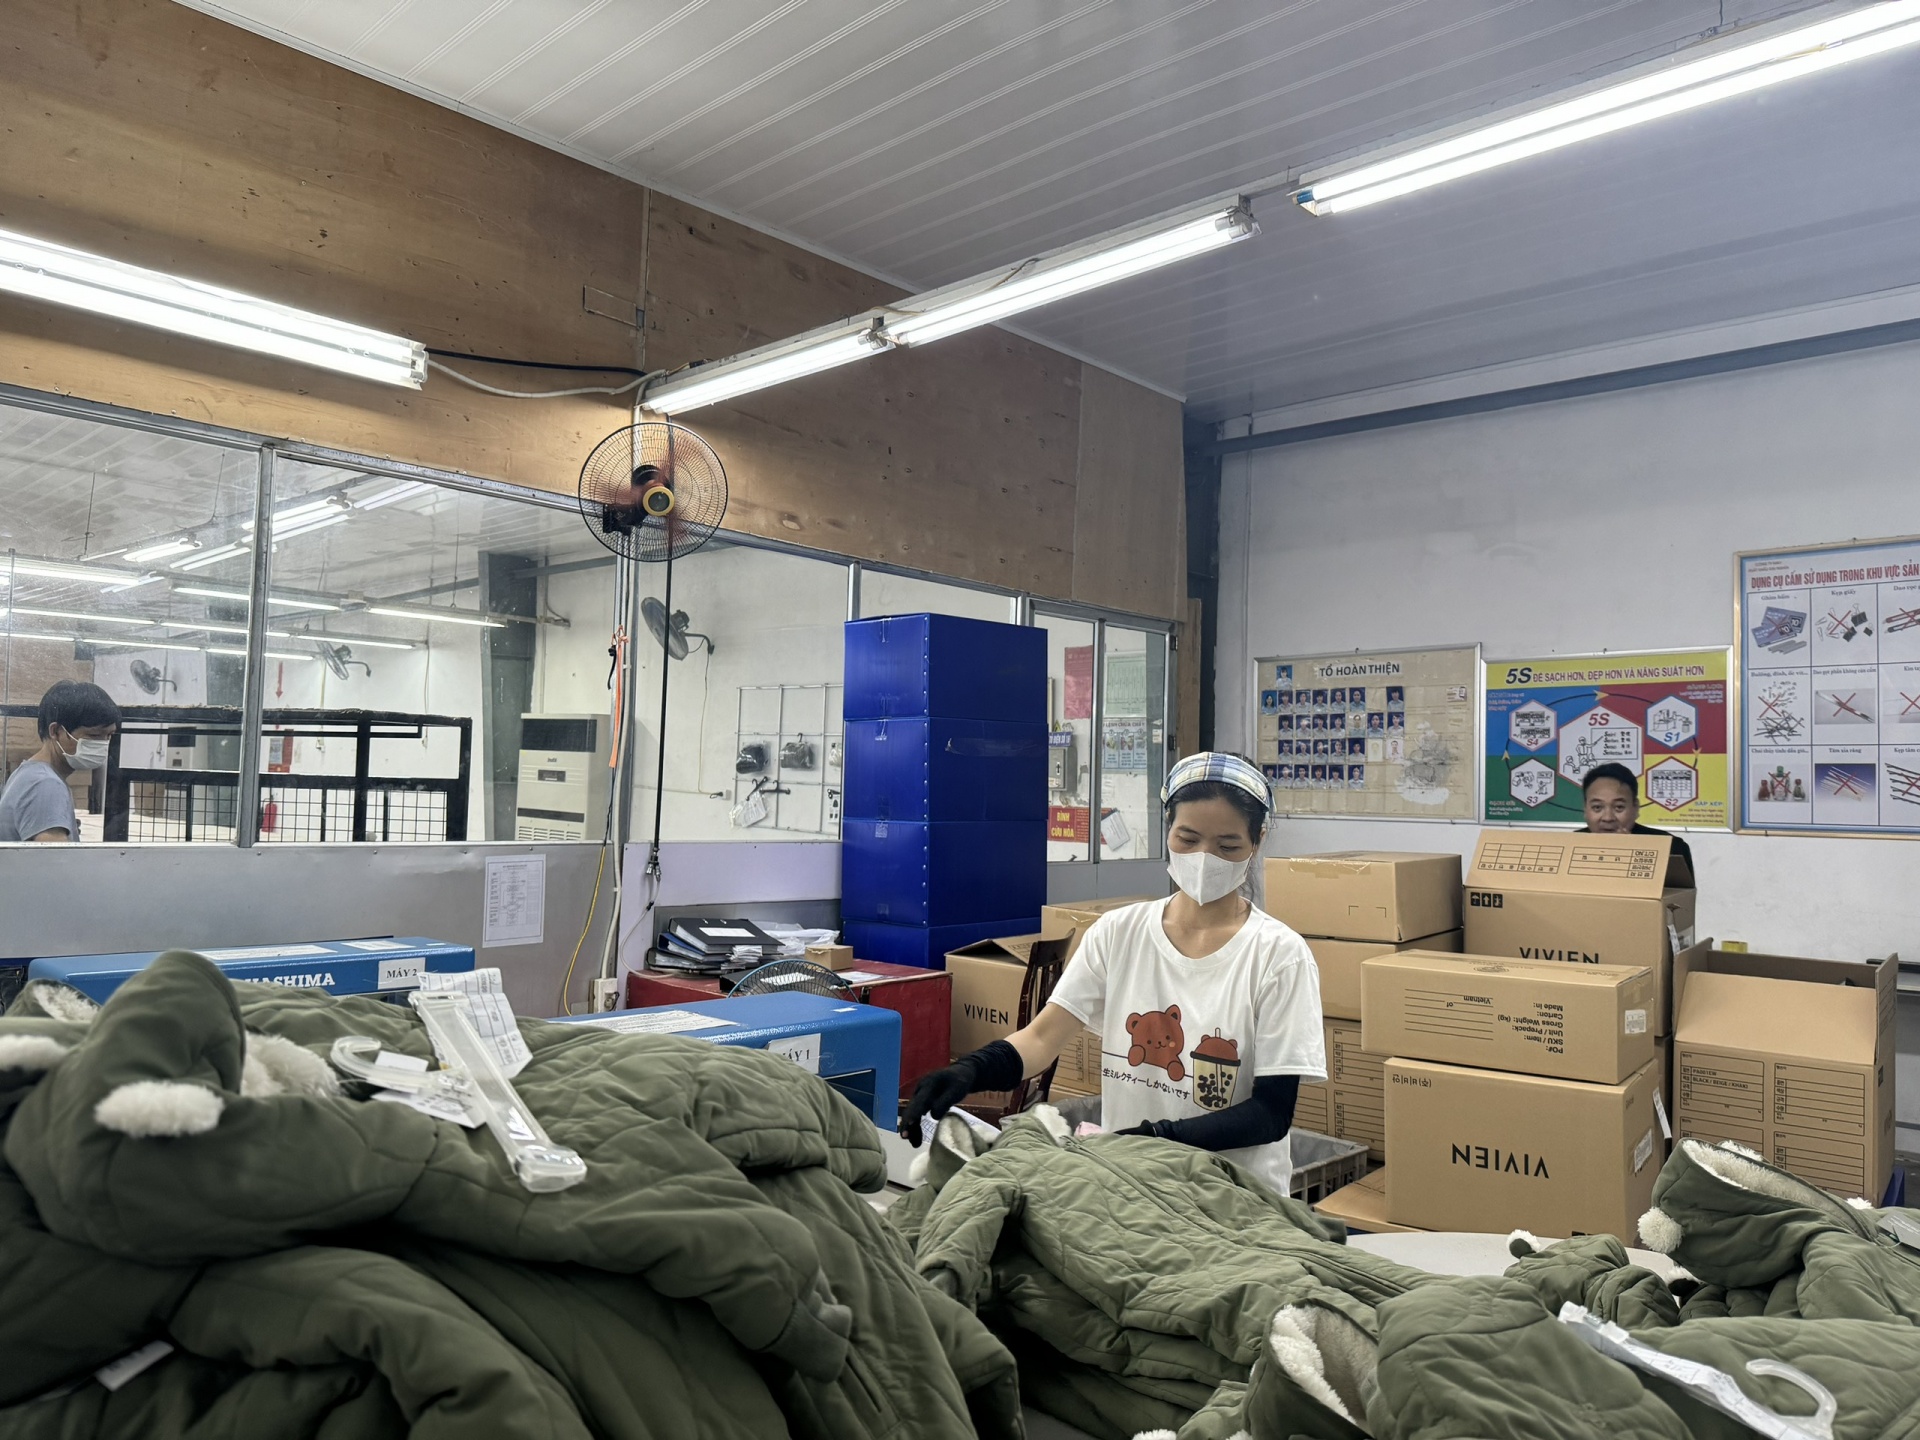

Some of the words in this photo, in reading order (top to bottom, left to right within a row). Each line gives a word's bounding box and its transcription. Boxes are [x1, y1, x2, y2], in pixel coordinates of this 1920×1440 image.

[1773, 575, 1783, 589] CỤ
[1804, 568, 1815, 584] SỬ
[1816, 571, 1837, 585] DỤNG
[1839, 568, 1865, 582] TRONG
[1866, 566, 1882, 579] KHU
[1884, 565, 1900, 580] VỰC
[1902, 559, 1919, 576] SẢN
[1320, 664, 1333, 676] TỔ
[1336, 664, 1366, 676] HOÀN
[1368, 662, 1400, 676] THIỆN
[1506, 667, 1532, 684] 5S
[1545, 672, 1566, 684] SẠCH
[1588, 670, 1603, 682] ĐẸP
[1605, 670, 1622, 679] HƠN
[1624, 667, 1635, 678] VÀ
[1686, 665, 1704, 676] HƠN
[1588, 713, 1610, 726] 5S
[1664, 732, 1681, 742] S1
[1526, 738, 1539, 746] S4
[1526, 796, 1538, 804] S3
[1664, 798, 1679, 806] S2
[1057, 810, 1070, 822] BÌNH
[1519, 946, 1600, 964] VIVIEN
[386, 968, 411, 979] MÁY
[412, 968, 417, 976] 2
[1463, 995, 1491, 1004] Vietnam
[1544, 1004, 1563, 1012] Made
[964, 1003, 1008, 1025] VIVIEN
[1498, 1014, 1511, 1022] (kg)
[1536, 1011, 1563, 1020] Carton:
[1513, 1017, 1540, 1026] Weight:
[1542, 1020, 1563, 1028] Gross
[1512, 1026, 1543, 1034] Prepack:
[1548, 1029, 1563, 1037] Unit
[1524, 1035, 1542, 1043] Item:
[783, 1048, 802, 1061] ÁY
[806, 1049, 810, 1059] 1
[1546, 1046, 1563, 1054] PO#:
[1102, 1068, 1190, 1100] 生ミルクティーしかないです
[1452, 1143, 1550, 1179] VIVIEN
